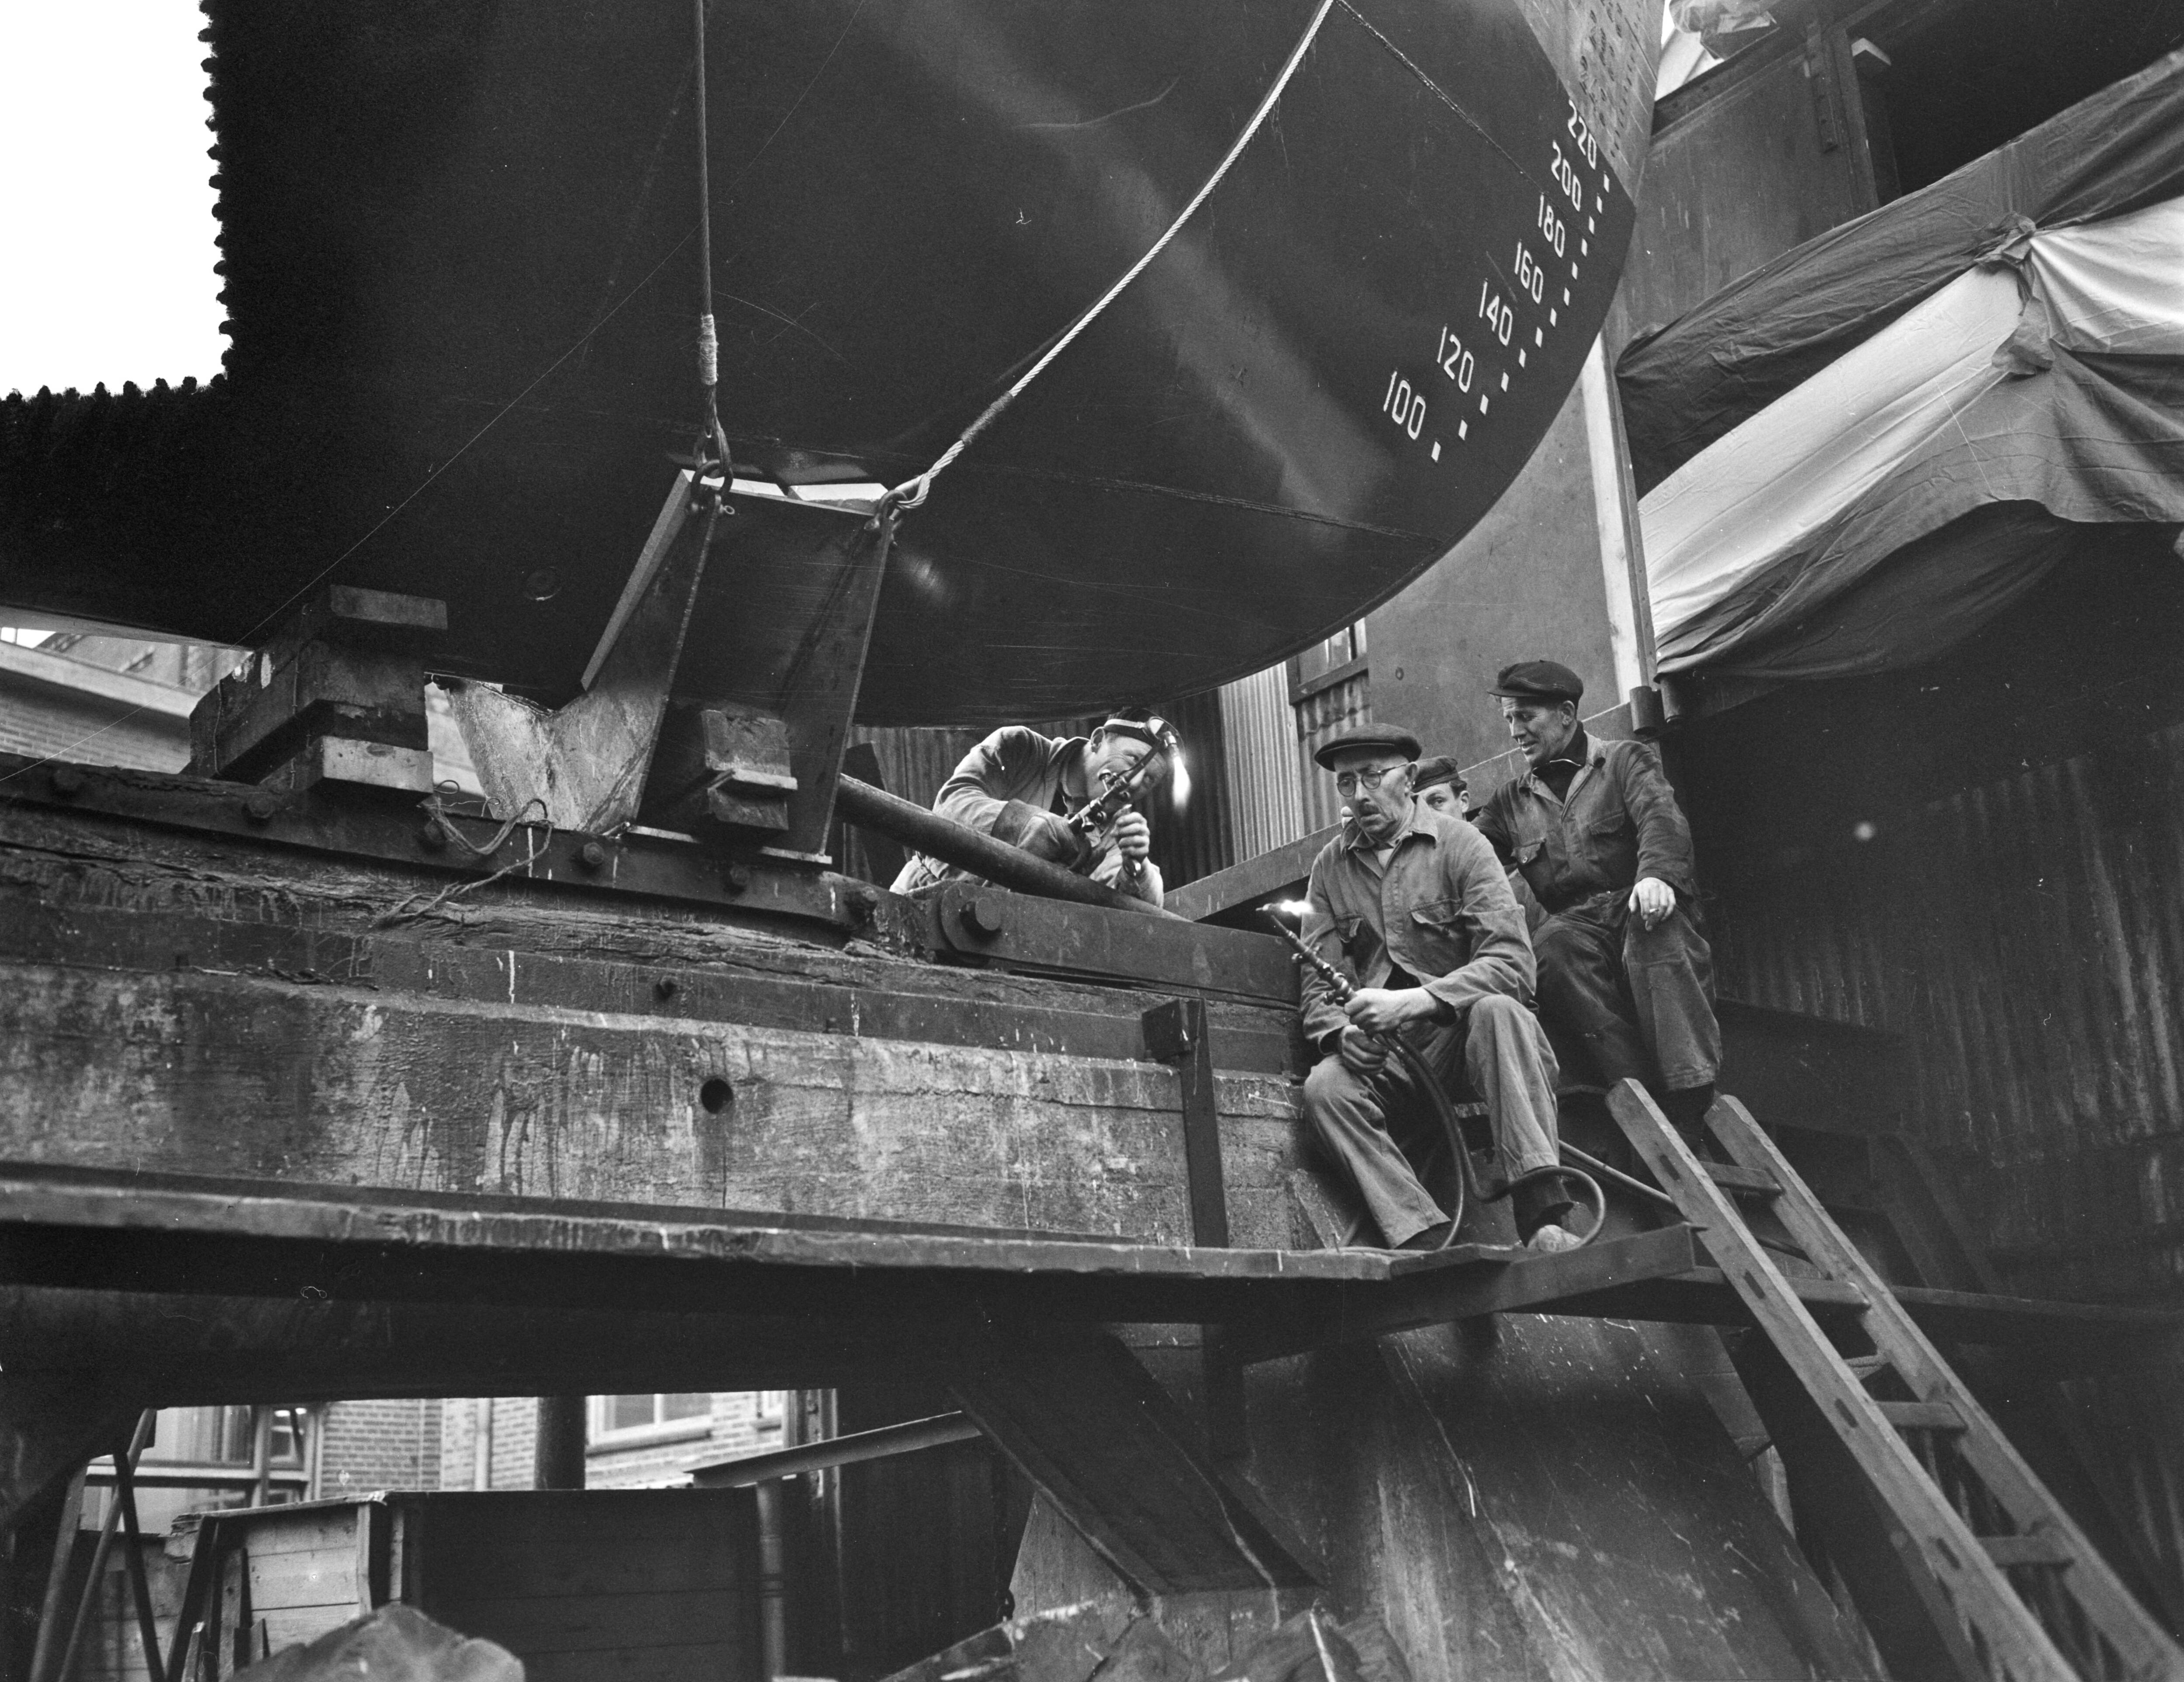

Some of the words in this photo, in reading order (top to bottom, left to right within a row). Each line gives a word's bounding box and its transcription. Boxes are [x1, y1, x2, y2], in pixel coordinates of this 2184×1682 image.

[1568, 100, 1597, 170] 220
[1551, 140, 1581, 211] 200
[1538, 194, 1565, 258] 180
[1514, 239, 1543, 304] 160
[1479, 278, 1513, 346] 140
[1437, 325, 1474, 393] 120
[1383, 370, 1426, 440] 100
